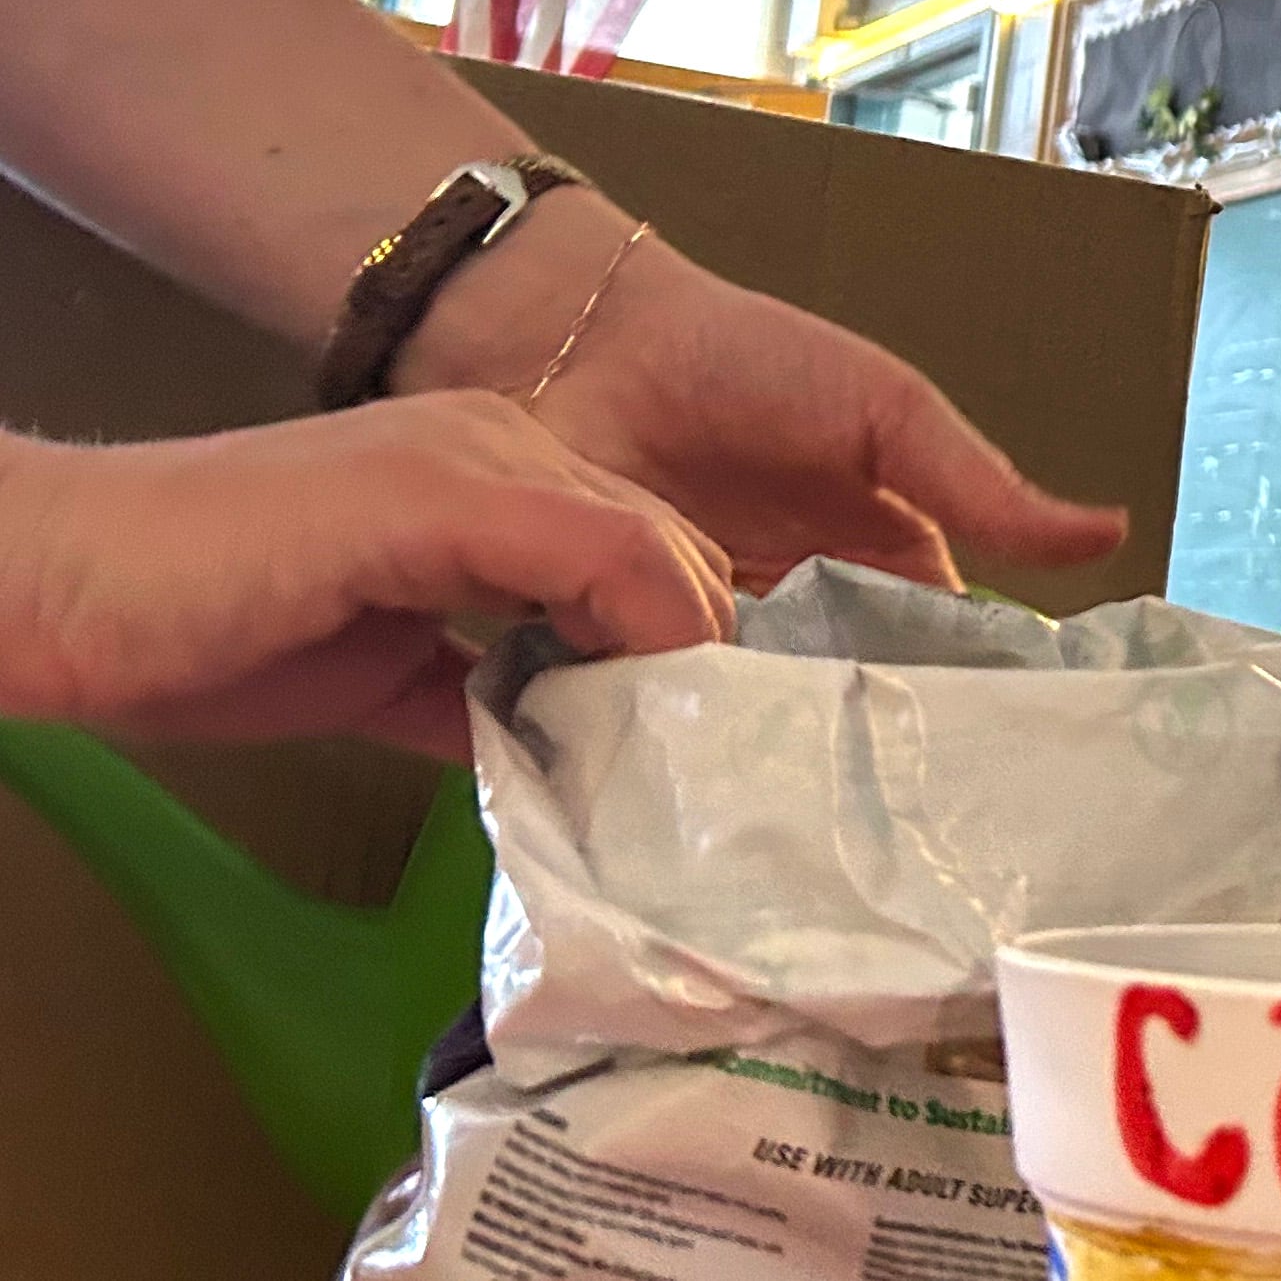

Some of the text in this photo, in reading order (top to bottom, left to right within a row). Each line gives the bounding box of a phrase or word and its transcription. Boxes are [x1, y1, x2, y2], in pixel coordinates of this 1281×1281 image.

[887, 1094, 920, 1121] to
[752, 1137, 808, 1171] USE
[812, 1152, 884, 1187] WITH
[885, 1166, 966, 1201] ADULT
